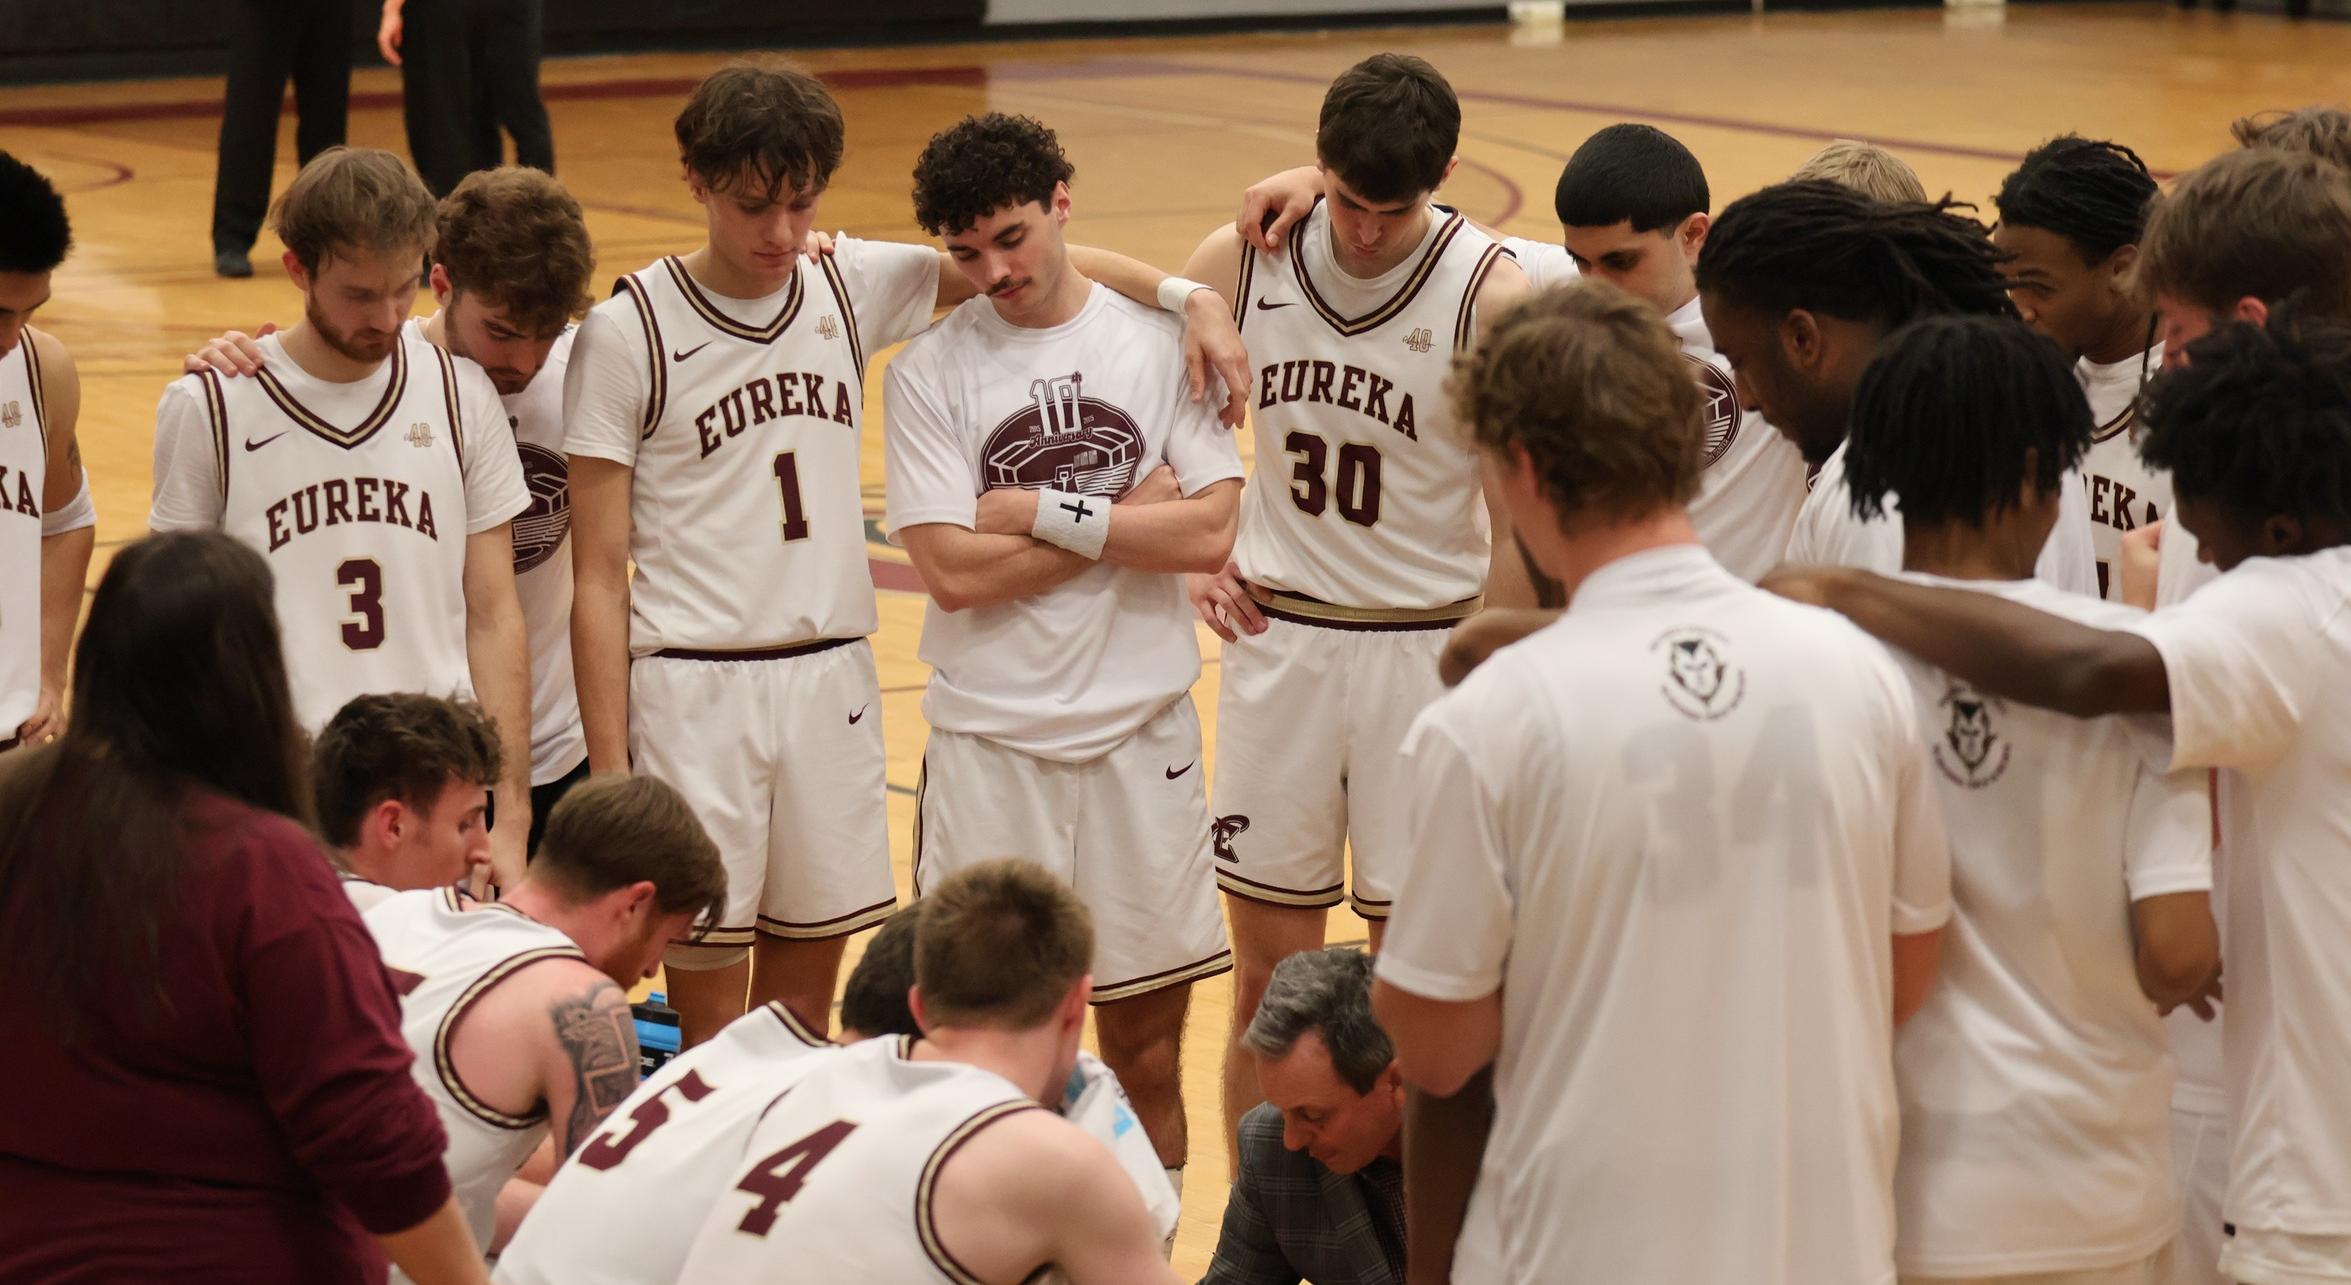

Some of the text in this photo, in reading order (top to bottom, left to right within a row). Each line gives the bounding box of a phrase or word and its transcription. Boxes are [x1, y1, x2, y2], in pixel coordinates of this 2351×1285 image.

[1407, 327, 1433, 353] 40
[409, 422, 433, 448] 40
[695, 372, 854, 460] EUREKA
[1028, 426, 1094, 449] Anniversary
[1259, 360, 1418, 442] EUREKA
[266, 477, 438, 554] EUREKA
[772, 448, 811, 545] 1
[1284, 428, 1383, 529] 30
[334, 556, 389, 652] 3
[577, 1068, 717, 1172] 5
[735, 1119, 858, 1239] 4
